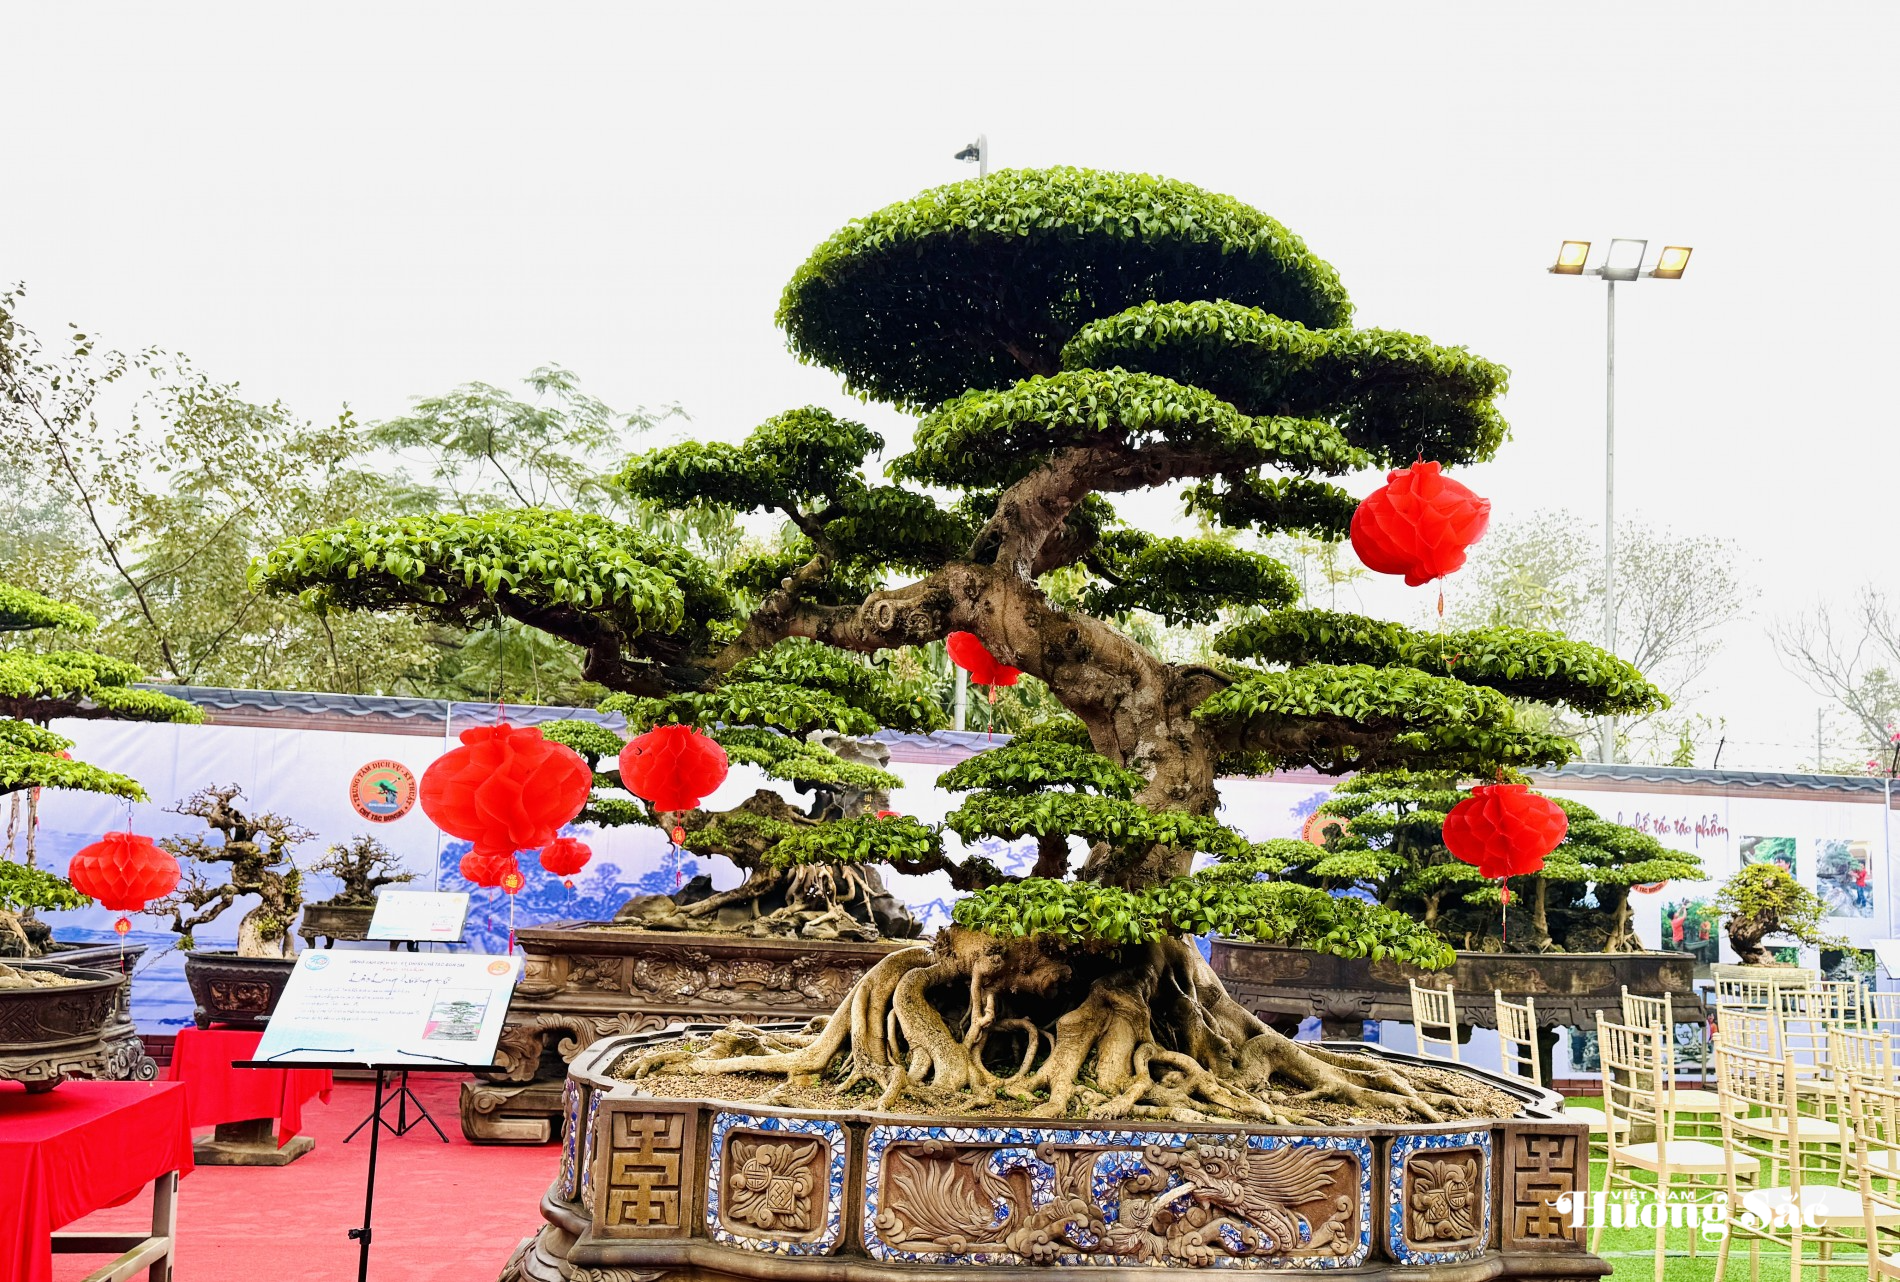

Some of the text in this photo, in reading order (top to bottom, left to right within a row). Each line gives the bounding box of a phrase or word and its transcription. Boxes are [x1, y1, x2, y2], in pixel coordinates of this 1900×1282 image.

[352, 778, 361, 803] TRUNG
[357, 765, 372, 778] TÂM
[372, 761, 390, 769] DỊCH
[392, 762, 402, 772] VỤ
[1695, 813, 1729, 849] phẩm
